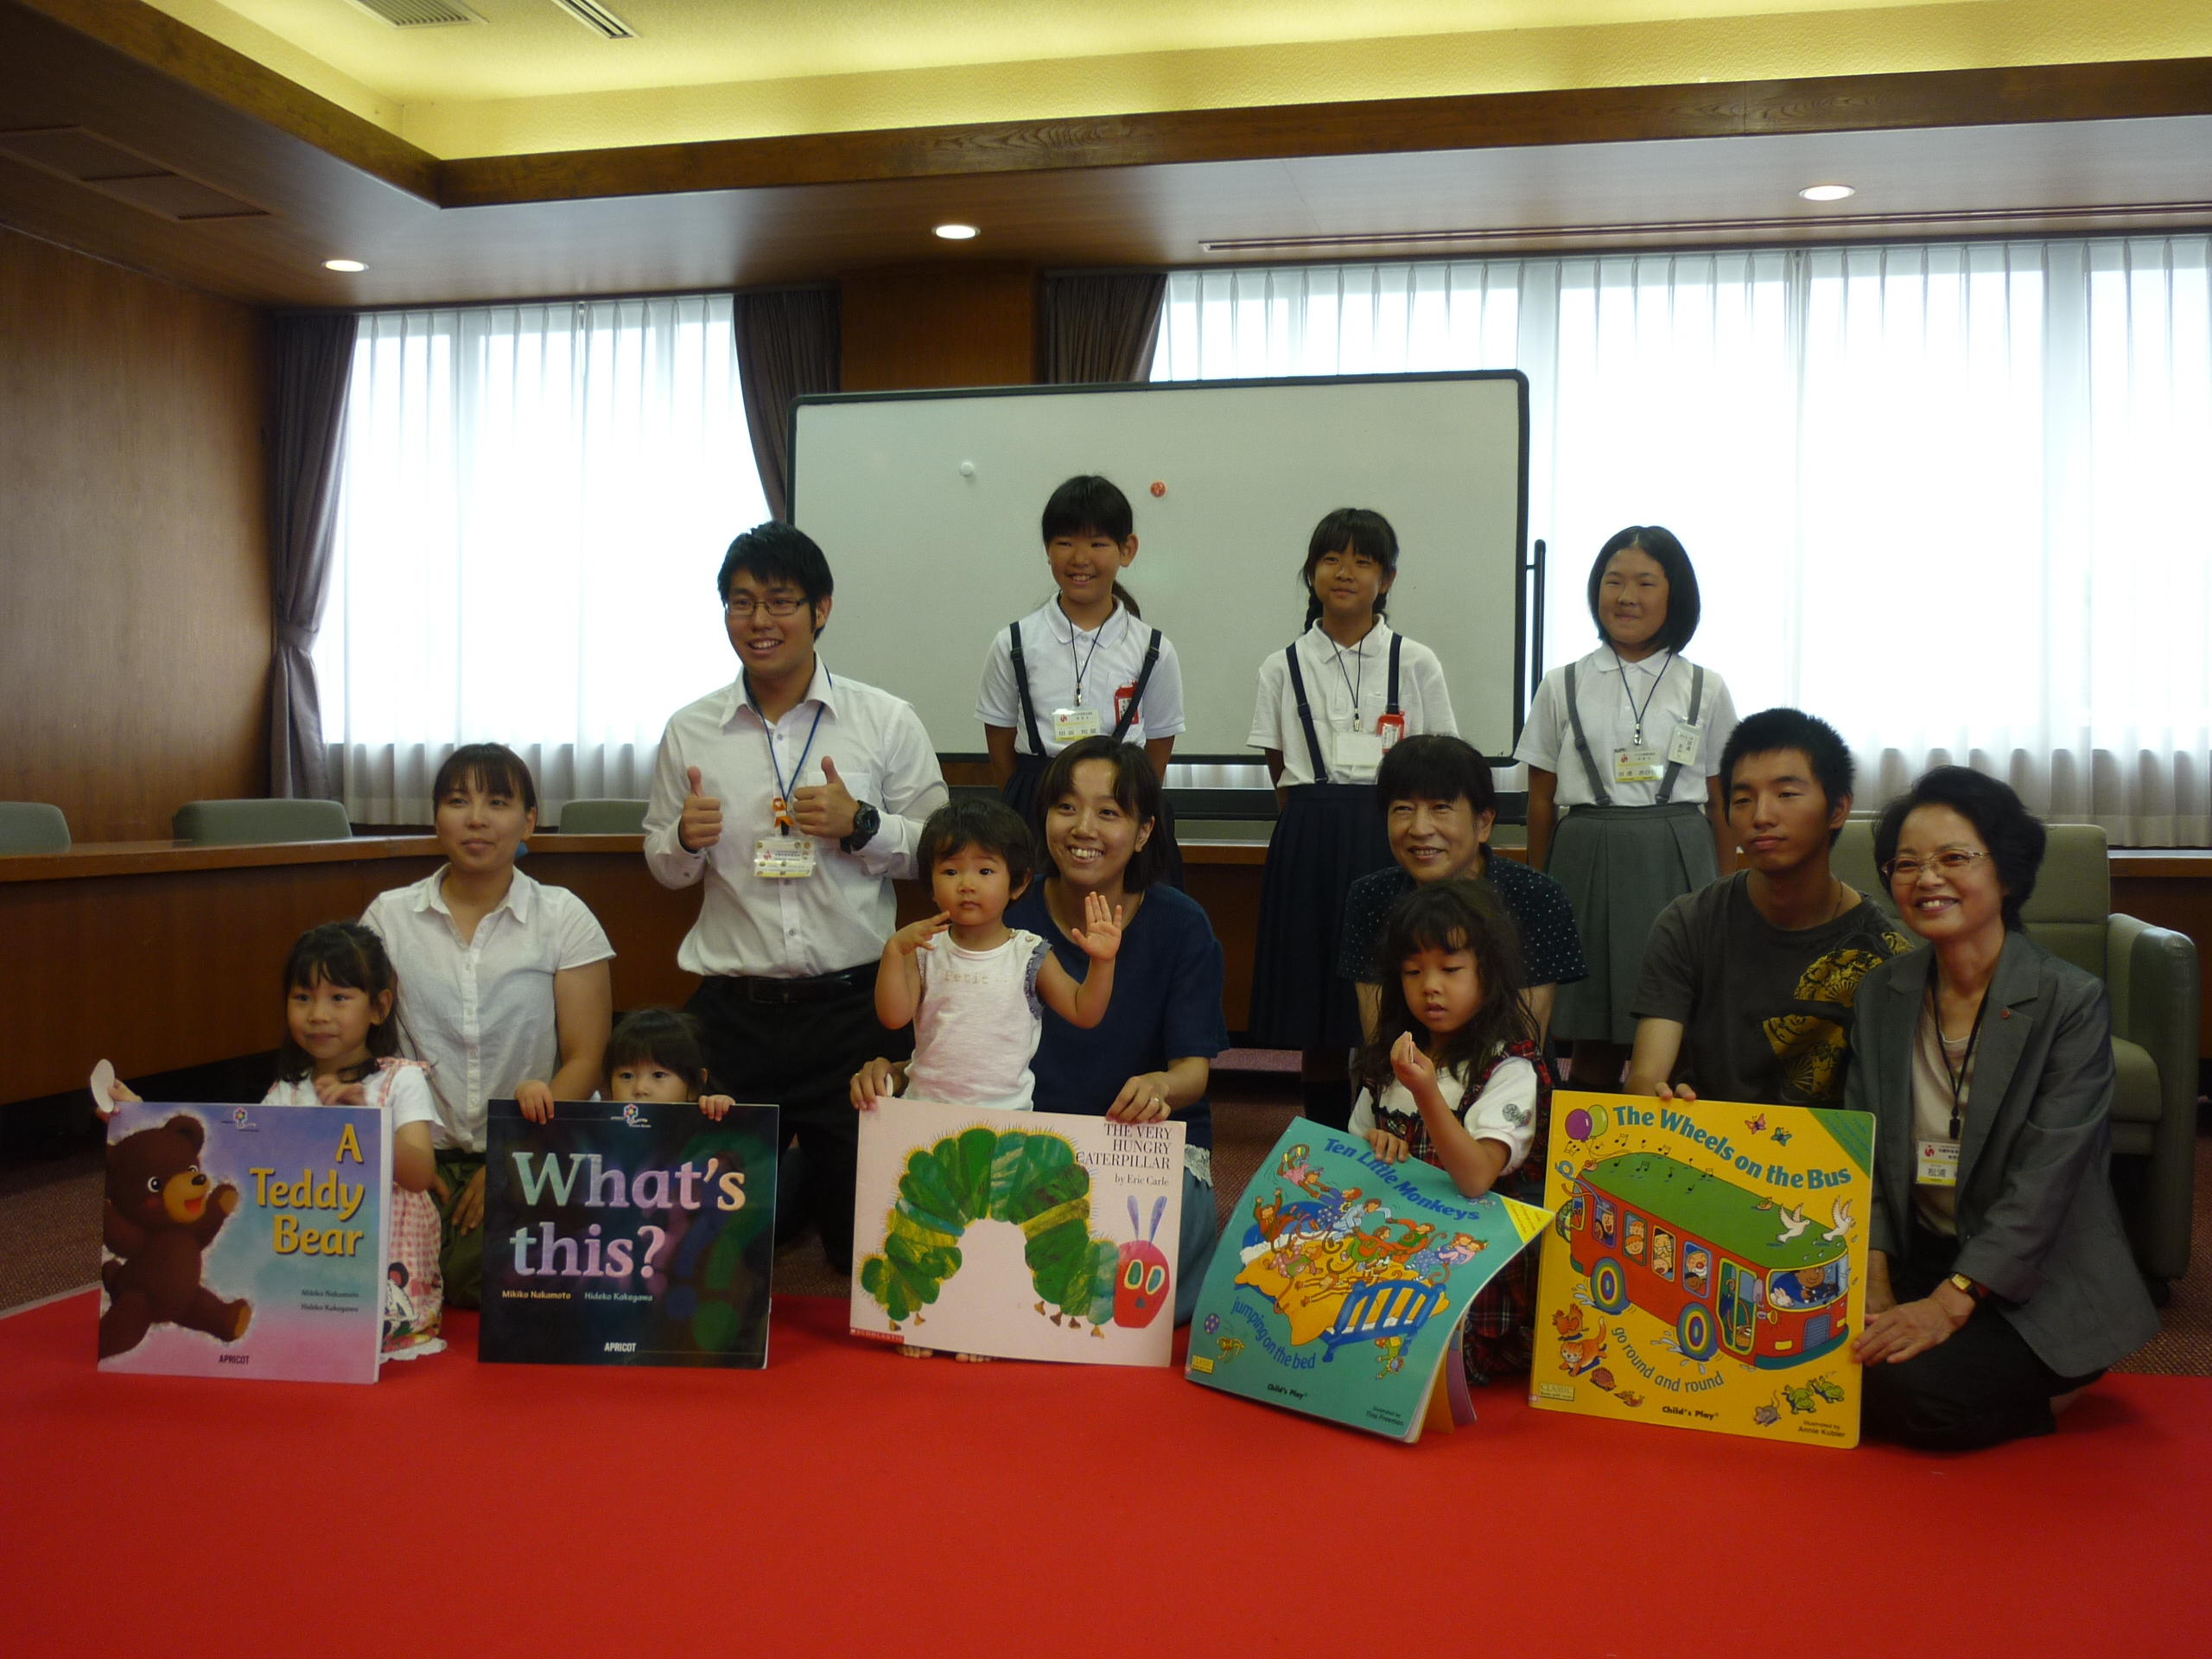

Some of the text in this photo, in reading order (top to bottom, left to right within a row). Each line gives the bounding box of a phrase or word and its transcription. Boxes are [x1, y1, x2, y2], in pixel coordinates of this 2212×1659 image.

[1104, 1123, 1173, 1140] THE VERY
[335, 1123, 364, 1163] A
[1113, 1139, 1172, 1154] HUNGRY
[1613, 1105, 1853, 1190] The Wheels on the Bus
[1076, 1151, 1171, 1170] CATERPILLAR
[512, 1152, 746, 1211] What's
[1115, 1173, 1169, 1186] by Eric Carle
[1324, 1137, 1358, 1158] Ten
[1356, 1150, 1399, 1185] Little
[1393, 1179, 1480, 1221] Monkeys
[249, 1167, 365, 1222] Teddy
[272, 1214, 364, 1257] Bear
[509, 1221, 666, 1279] this?
[502, 1290, 653, 1303] Mikiko Nakamoto Hideko Kakegawa
[1230, 1296, 1316, 1370] jumping on the bed
[604, 1342, 637, 1352] APRICOT
[219, 1354, 250, 1365] APRICOT
[1611, 1327, 1725, 1393] go round and round
[1267, 1383, 1287, 1395] Child's
[1541, 1383, 1573, 1394] CLASSIC
[1662, 1406, 1714, 1421] Child's Play
[1798, 1426, 1846, 1438] Annie Kubler
